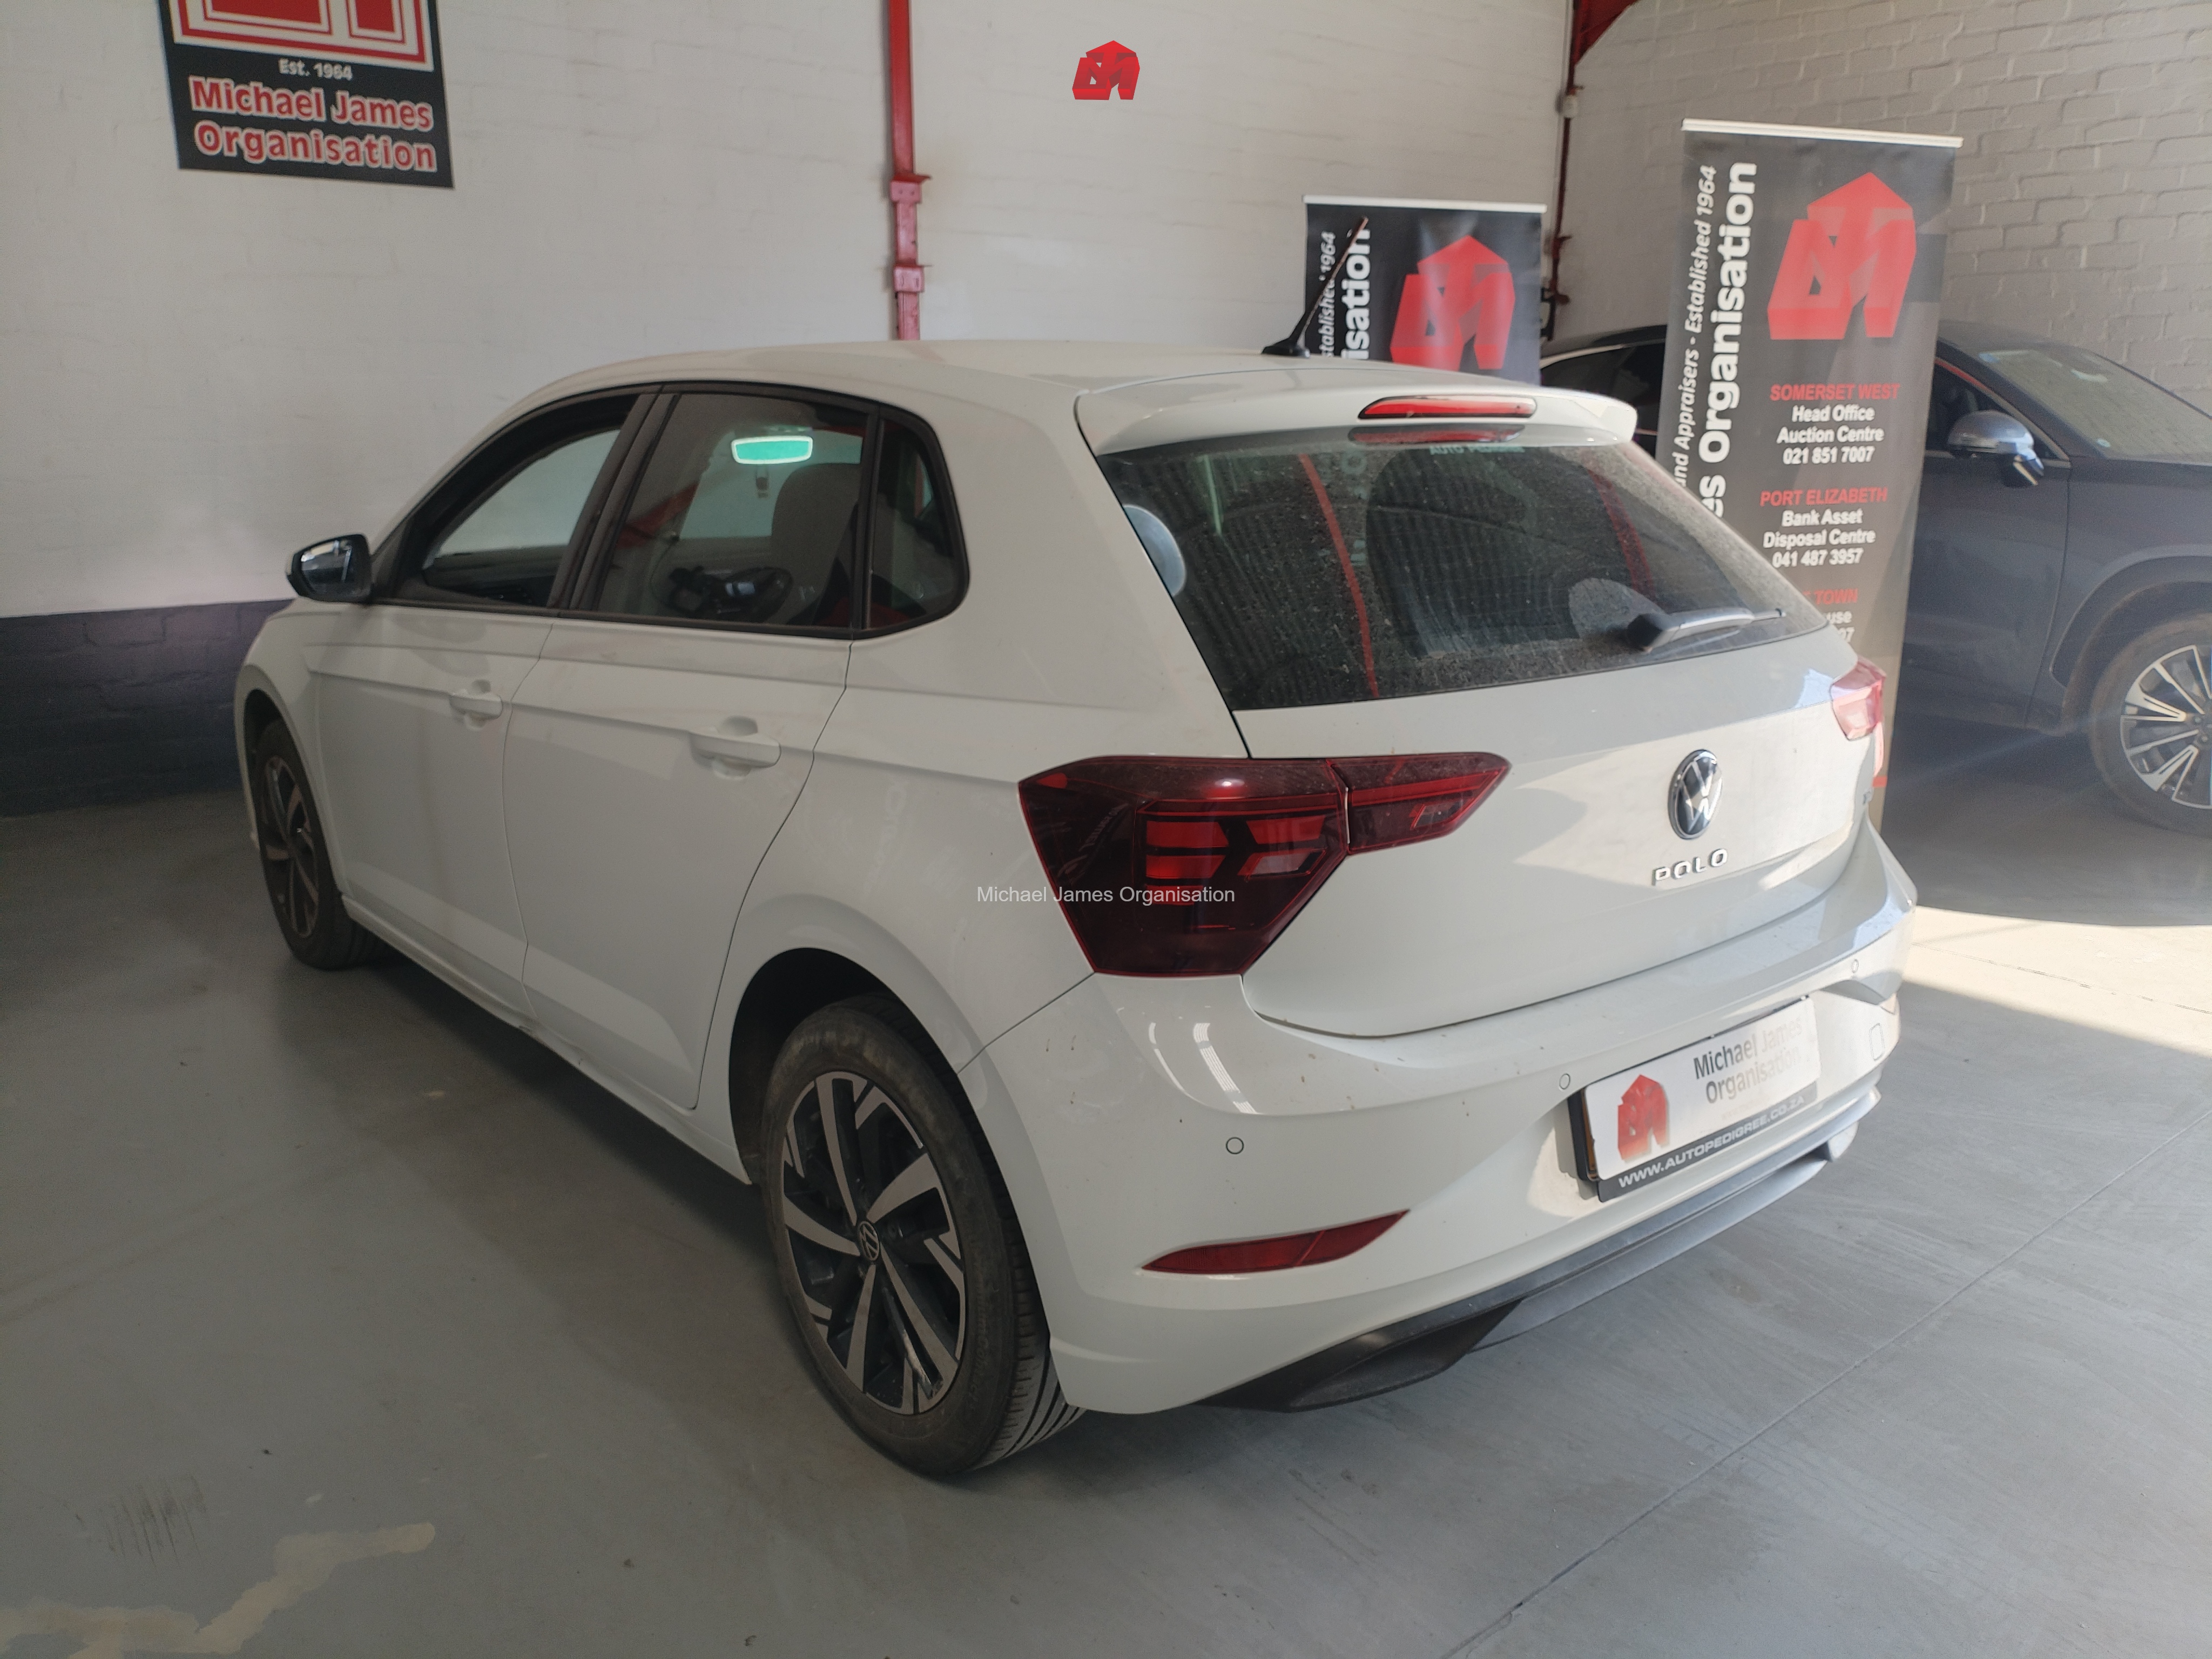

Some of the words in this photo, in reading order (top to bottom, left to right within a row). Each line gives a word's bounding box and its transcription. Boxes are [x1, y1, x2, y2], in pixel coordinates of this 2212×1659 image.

[279, 59, 309, 76] Est.
[314, 63, 353, 81] 1964
[188, 75, 326, 122] Michael
[331, 90, 434, 132] James
[195, 120, 437, 172] Organisation
[1696, 165, 1717, 215] 1964
[1320, 231, 1336, 273] 1964
[1684, 219, 1711, 333] Established
[1674, 348, 1700, 450] Appraisers
[1770, 383, 1855, 401] SOMERSET
[1858, 382, 1900, 400] WEST
[1792, 405, 1831, 422] Head
[1832, 404, 1875, 421] Office
[1776, 426, 1835, 443] Auction
[1837, 424, 1885, 442] Centre
[1783, 447, 1809, 464] 021
[1811, 446, 1837, 464] 851
[1841, 446, 1875, 463] 7007
[1759, 490, 1803, 507] PORT
[1805, 486, 1888, 505] ELIZABETH
[1782, 509, 1820, 527] Bank
[1820, 508, 1863, 525] Asset
[1763, 529, 1827, 550] Disposal
[1829, 528, 1876, 545] Centre
[1772, 550, 1798, 568] 041
[1800, 549, 1828, 566] 487
[1829, 547, 1864, 565] 3957
[1814, 588, 1858, 605] TOWN
[1652, 848, 1728, 886] POLO
[1694, 1034, 1758, 1079] Michael
[1761, 1017, 1803, 1053] James
[1706, 1046, 1800, 1103] Organisation
[1618, 1096, 1804, 1188] WWW.AUTOPEDIGREE.CO.ZA
